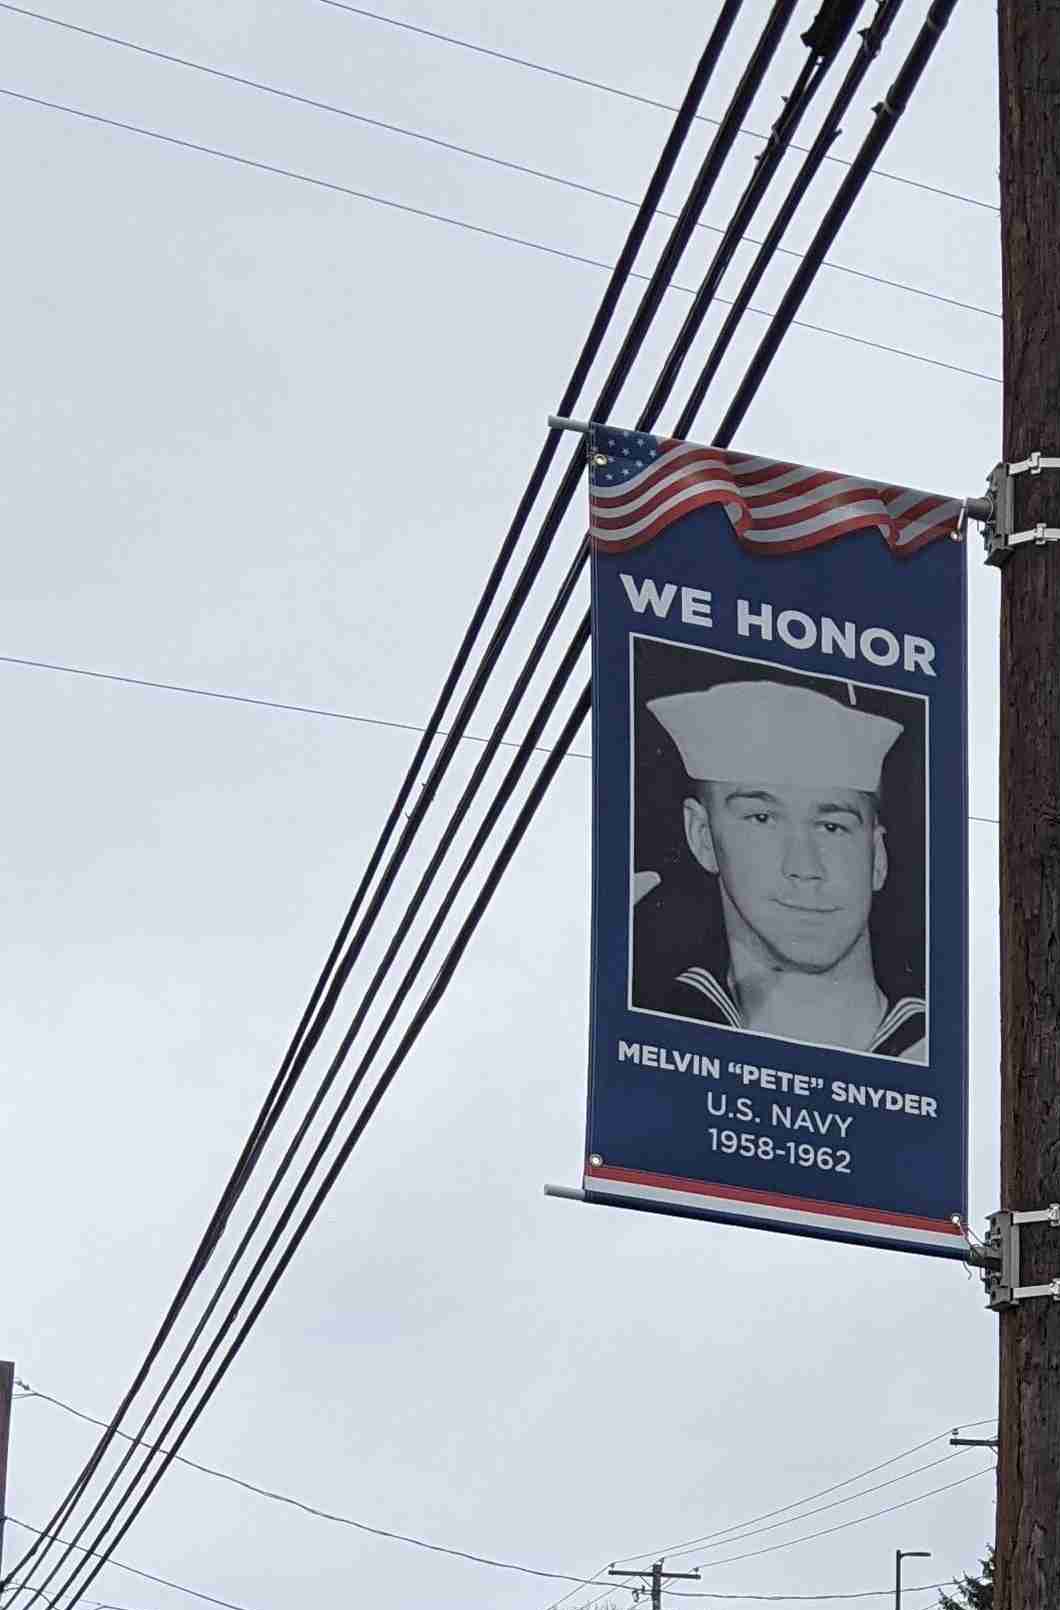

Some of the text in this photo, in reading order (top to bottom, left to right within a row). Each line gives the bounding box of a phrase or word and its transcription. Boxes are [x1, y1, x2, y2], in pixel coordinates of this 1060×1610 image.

[619, 573, 937, 677] WE HONOR
[617, 1040, 937, 1118] MELVIN “PETE” SNYDER
[706, 1091, 853, 1138] U.S. NAVY
[708, 1127, 851, 1173] 1958-1962
